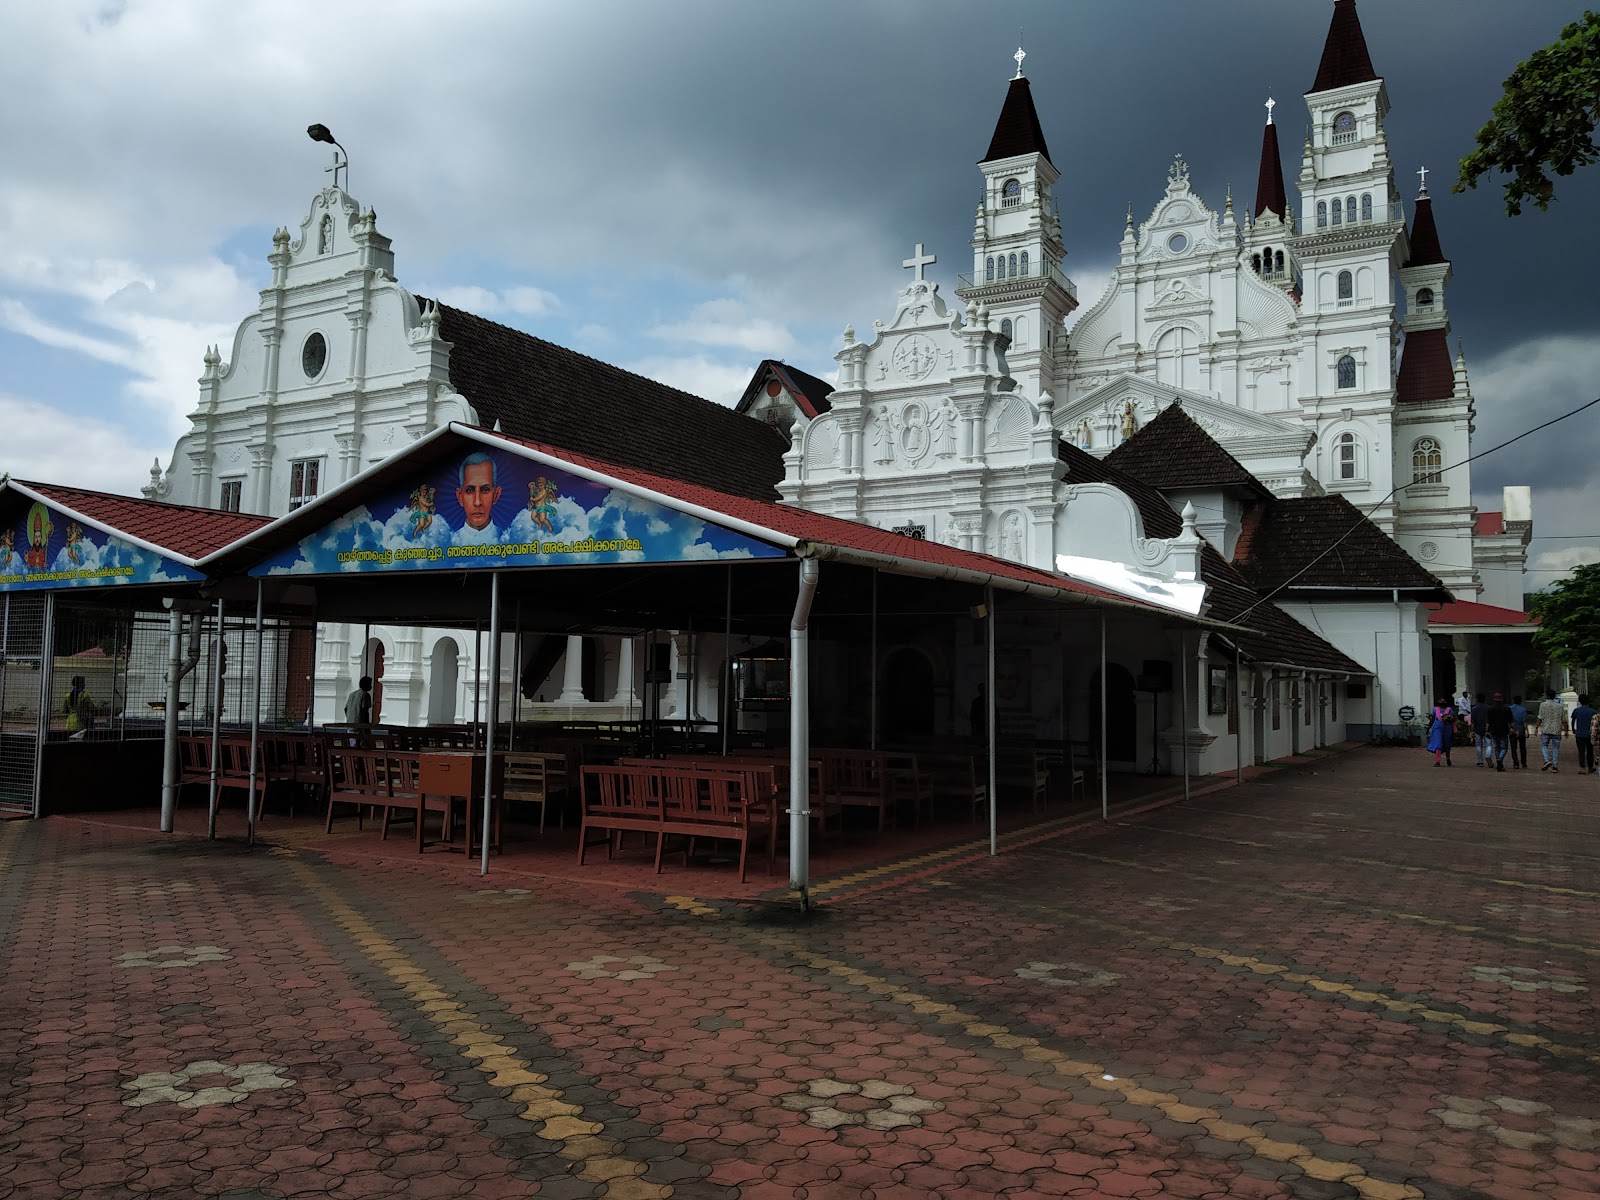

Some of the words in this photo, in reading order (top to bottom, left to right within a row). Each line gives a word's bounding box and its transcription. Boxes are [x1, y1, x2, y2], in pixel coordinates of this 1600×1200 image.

[337, 548, 392, 564] വാഴ്ത്തപ്പെട്ട
[447, 540, 539, 559] ഞങ്ങൾക്കുവേണ്ടി
[542, 537, 643, 554] അപേക്ഷിക്കണമേ.
